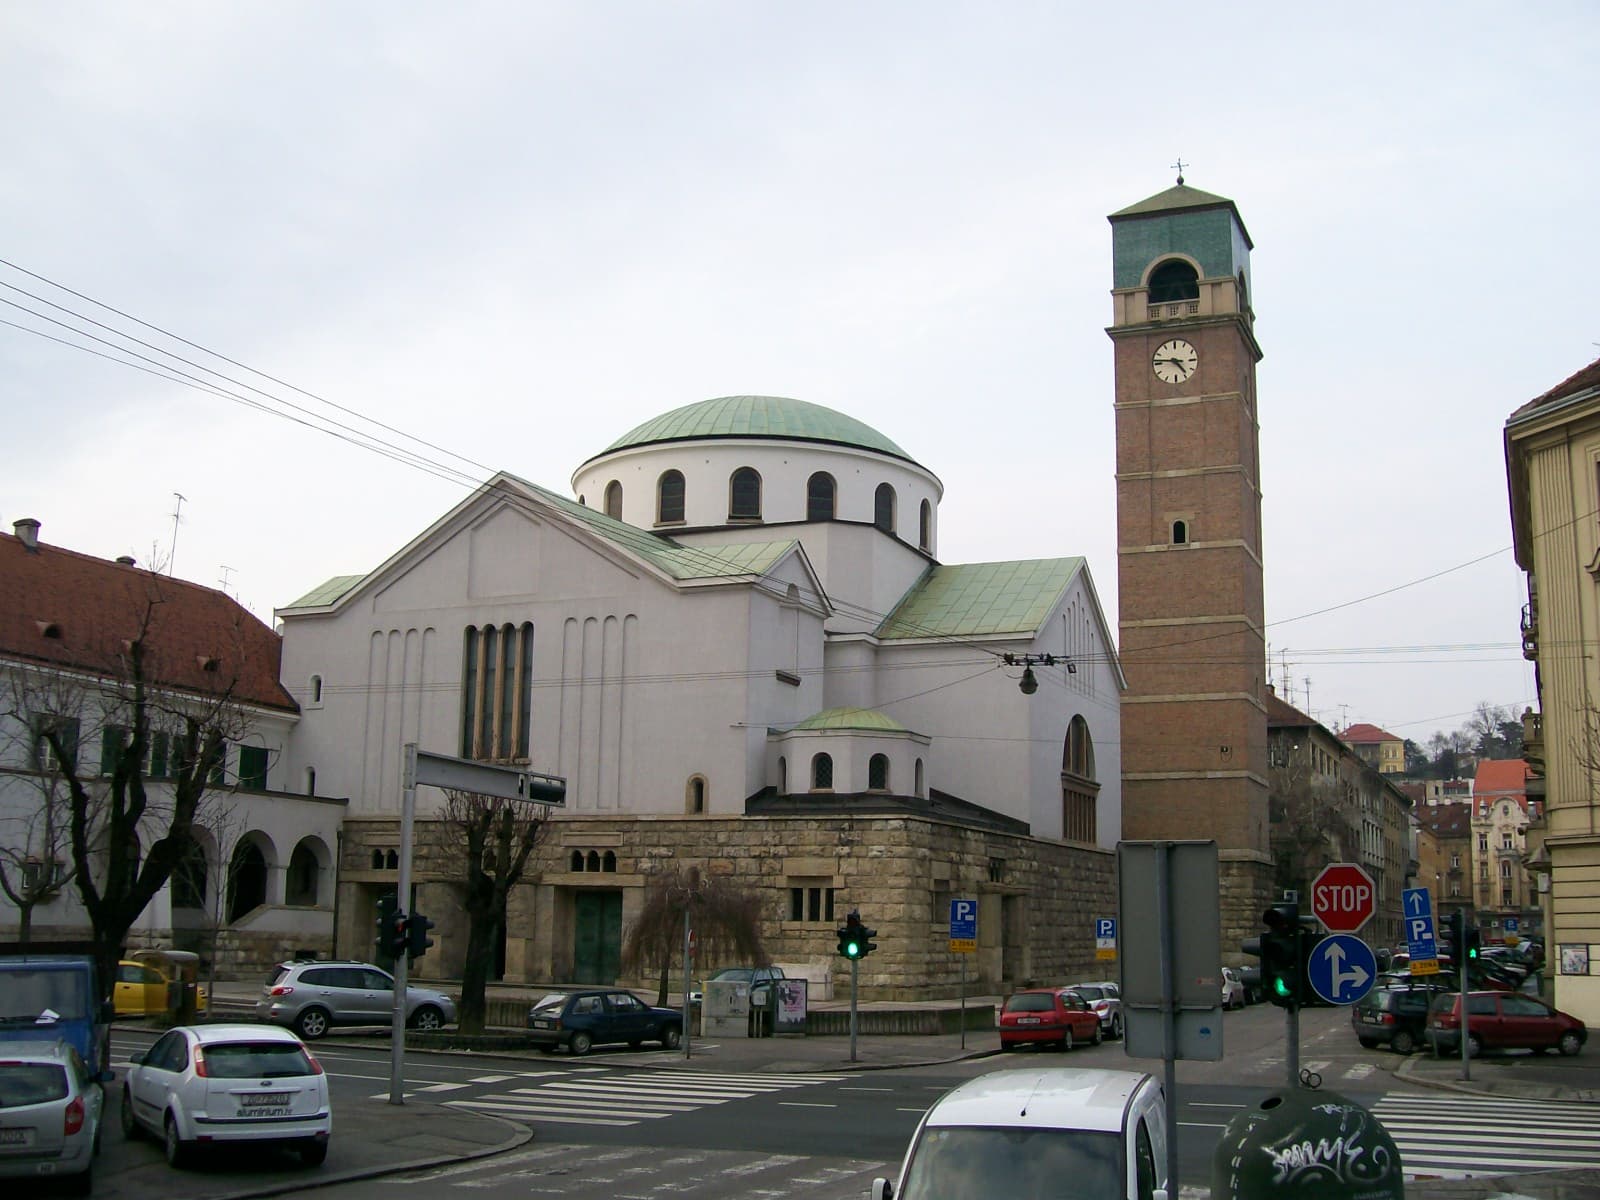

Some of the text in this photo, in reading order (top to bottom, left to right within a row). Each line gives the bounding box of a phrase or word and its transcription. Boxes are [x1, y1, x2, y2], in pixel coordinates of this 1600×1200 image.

[1316, 885, 1370, 912] STOP
[957, 902, 970, 921] P
[1101, 920, 1112, 935] P
[1412, 920, 1426, 941] P
